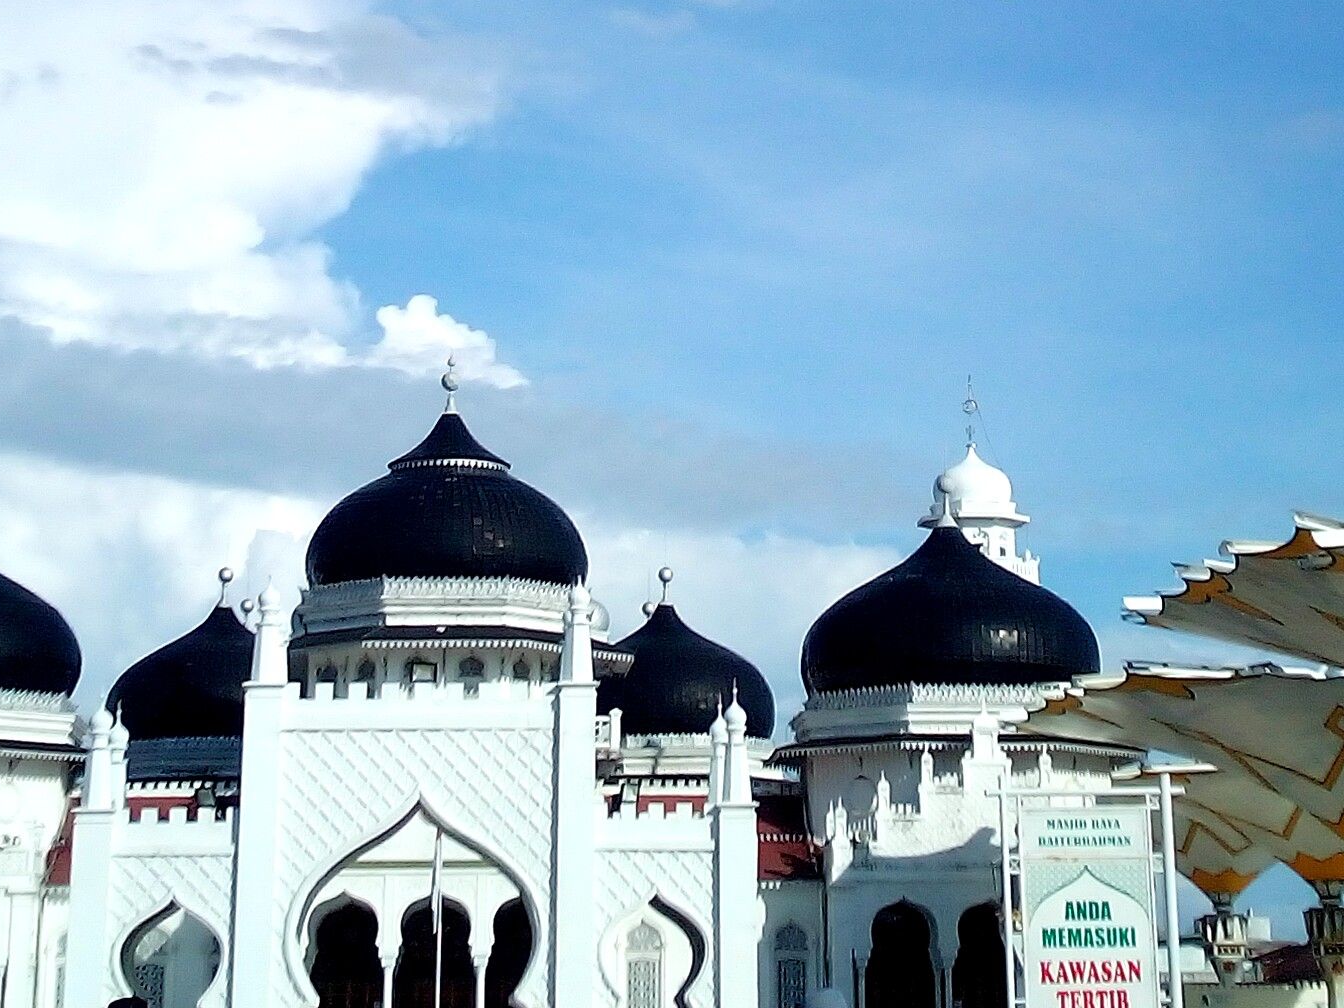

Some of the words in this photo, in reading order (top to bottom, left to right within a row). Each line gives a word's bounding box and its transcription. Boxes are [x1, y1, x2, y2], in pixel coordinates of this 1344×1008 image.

[1047, 819, 1087, 830] MASJID
[1091, 819, 1120, 830] RAYA
[1065, 900, 1112, 921] ANDA
[1042, 927, 1136, 948] MEMASUKI
[1040, 960, 1142, 984] KAWASAN
[1056, 990, 1129, 1008] TERTIB
